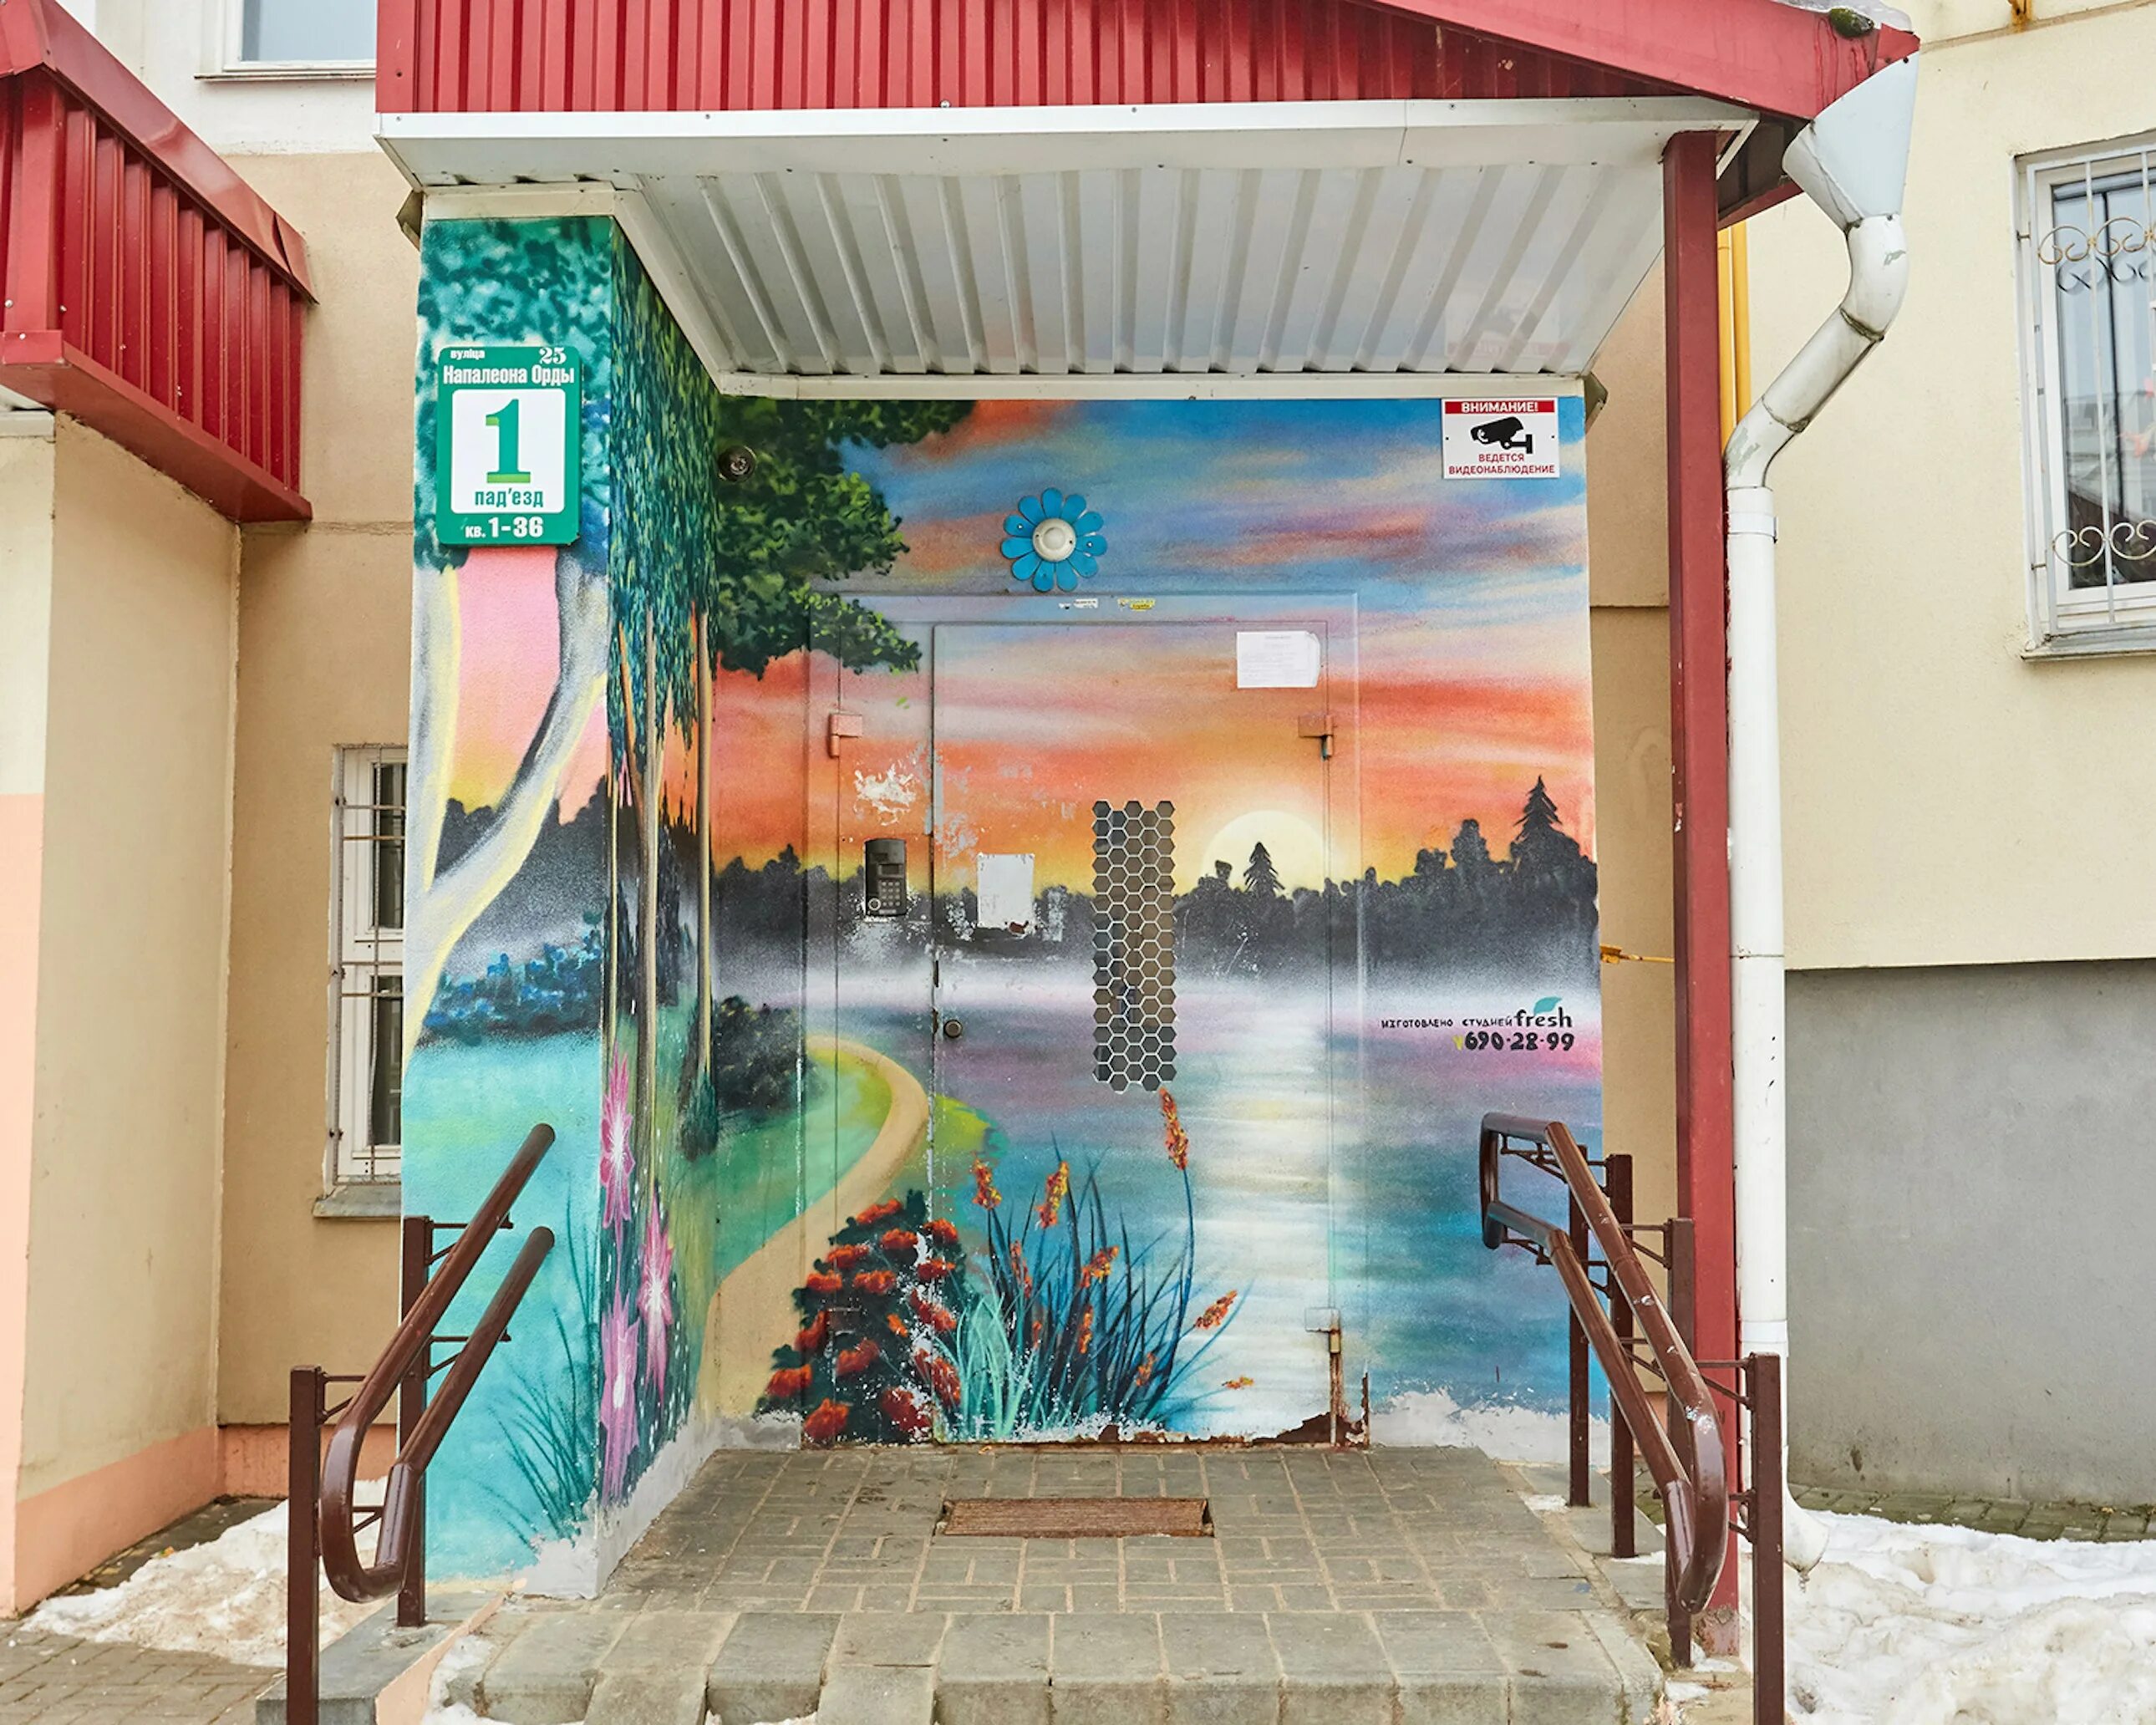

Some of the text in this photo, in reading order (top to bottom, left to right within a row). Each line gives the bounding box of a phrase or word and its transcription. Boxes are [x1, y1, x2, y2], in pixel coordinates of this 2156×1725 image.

[450, 349, 486, 359] вуліца
[539, 347, 567, 364] 25
[443, 364, 575, 386] Напалеона Орды
[1462, 402, 1538, 413] ВНИМАНИЕ!
[486, 399, 531, 483] 1
[1478, 454, 1524, 463] ВЕДЕТСЯ
[1448, 465, 1555, 475] ВИДЕОНАБЛЮДЕНИЕ
[475, 488, 544, 508] пад'езд
[465, 516, 543, 538] кв. 1-36
[1513, 1006, 1573, 1028] fresh
